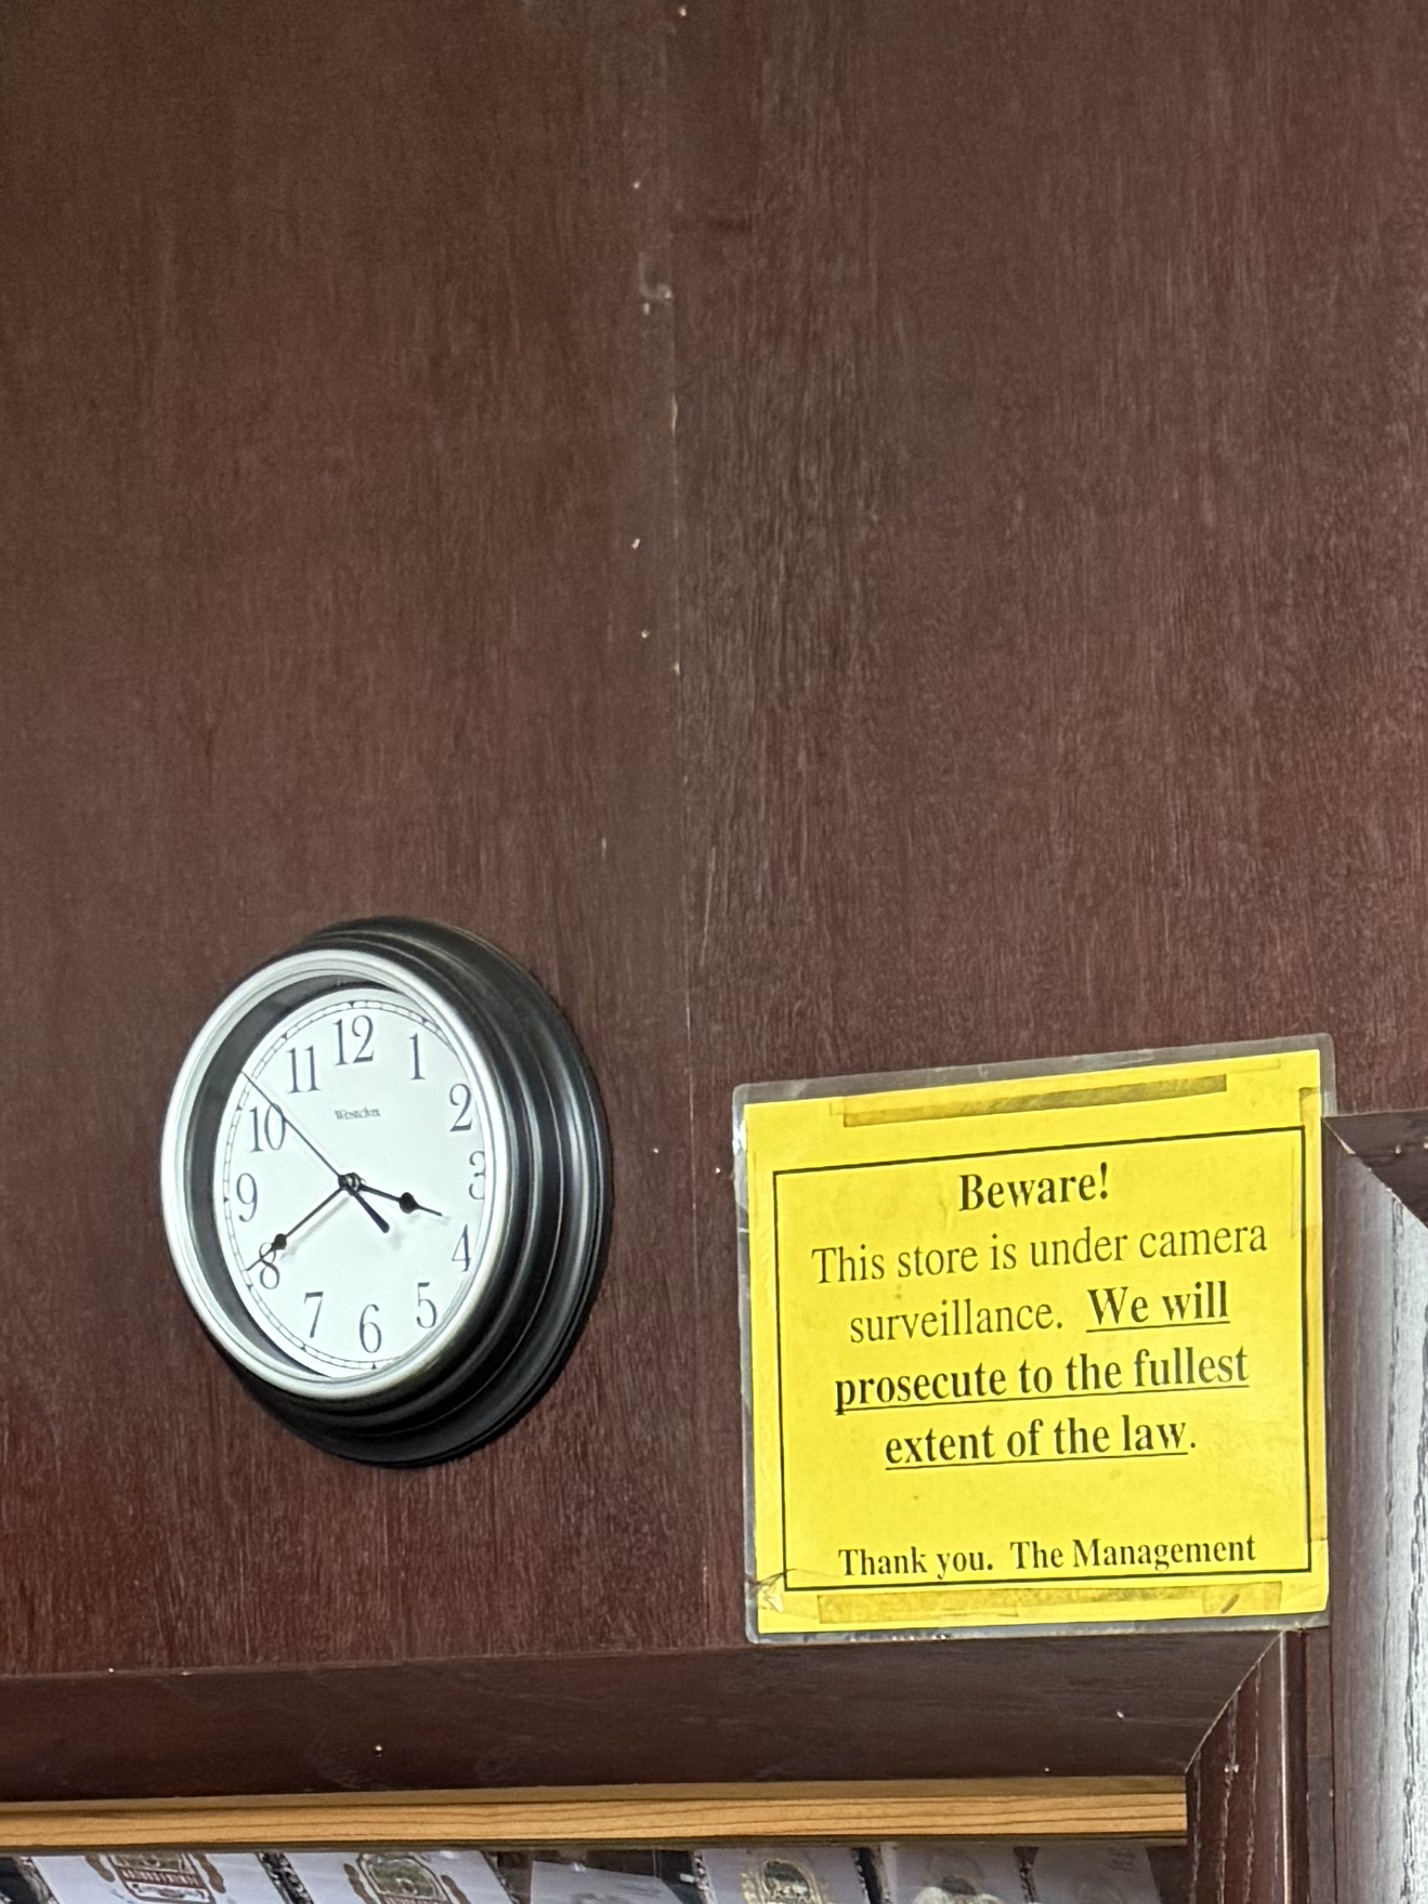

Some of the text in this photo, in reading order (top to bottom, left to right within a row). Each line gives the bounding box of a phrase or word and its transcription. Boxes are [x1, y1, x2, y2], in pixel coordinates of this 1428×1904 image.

[335, 1015, 374, 1066] 12
[410, 1034, 425, 1080] 1
[287, 1046, 320, 1093] 11
[250, 1104, 286, 1152] 10
[449, 1084, 472, 1132] 2
[237, 1173, 257, 1222] 9
[469, 1151, 486, 1200] 3
[958, 1163, 1110, 1211] Beware!
[259, 1241, 280, 1289] 8
[451, 1225, 470, 1272] 4
[811, 1225, 1267, 1284] This store is under camera
[304, 1292, 323, 1338] 7
[360, 1305, 381, 1353] 6
[417, 1282, 437, 1328] 5
[850, 1281, 1229, 1344] surveillance. We will
[834, 1347, 1248, 1415] prosecute to the fullest
[885, 1415, 1197, 1464] extent of the law.
[839, 1535, 1256, 1579] Thank you. The Management
